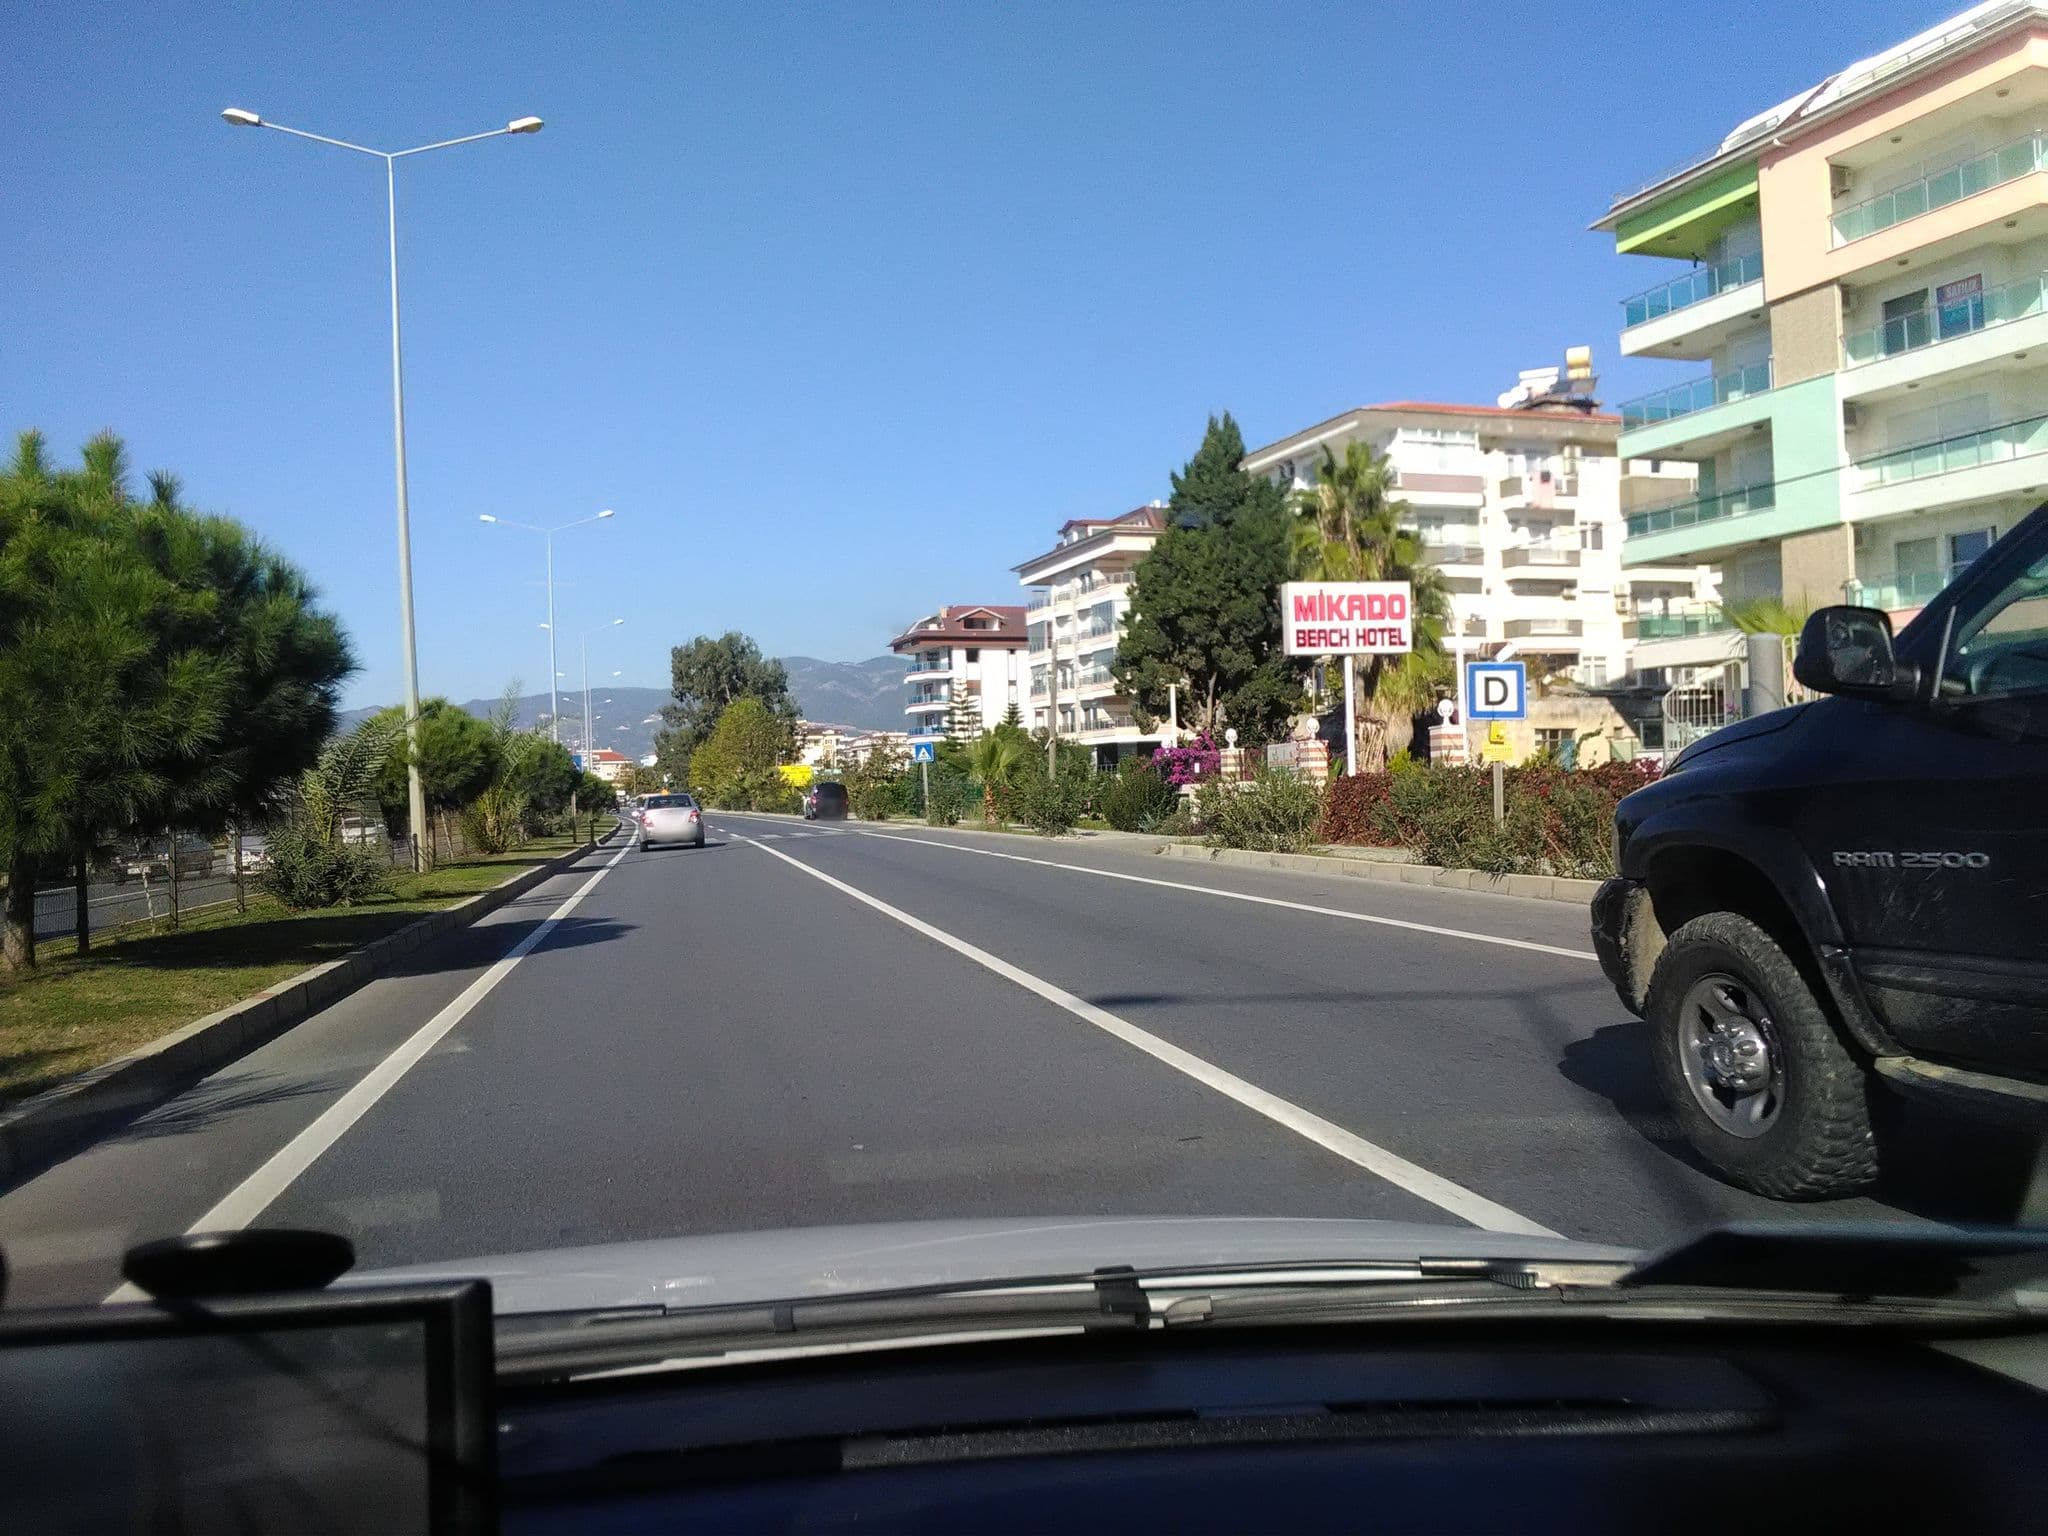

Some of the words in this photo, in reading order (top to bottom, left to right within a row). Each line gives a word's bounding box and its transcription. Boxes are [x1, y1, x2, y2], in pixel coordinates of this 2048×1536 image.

[1296, 628, 1350, 648] BEACH
[1356, 627, 1407, 647] HOTEL
[1484, 676, 1509, 706] D
[1832, 851, 1896, 868] RAM
[1900, 851, 1990, 869] 2500
